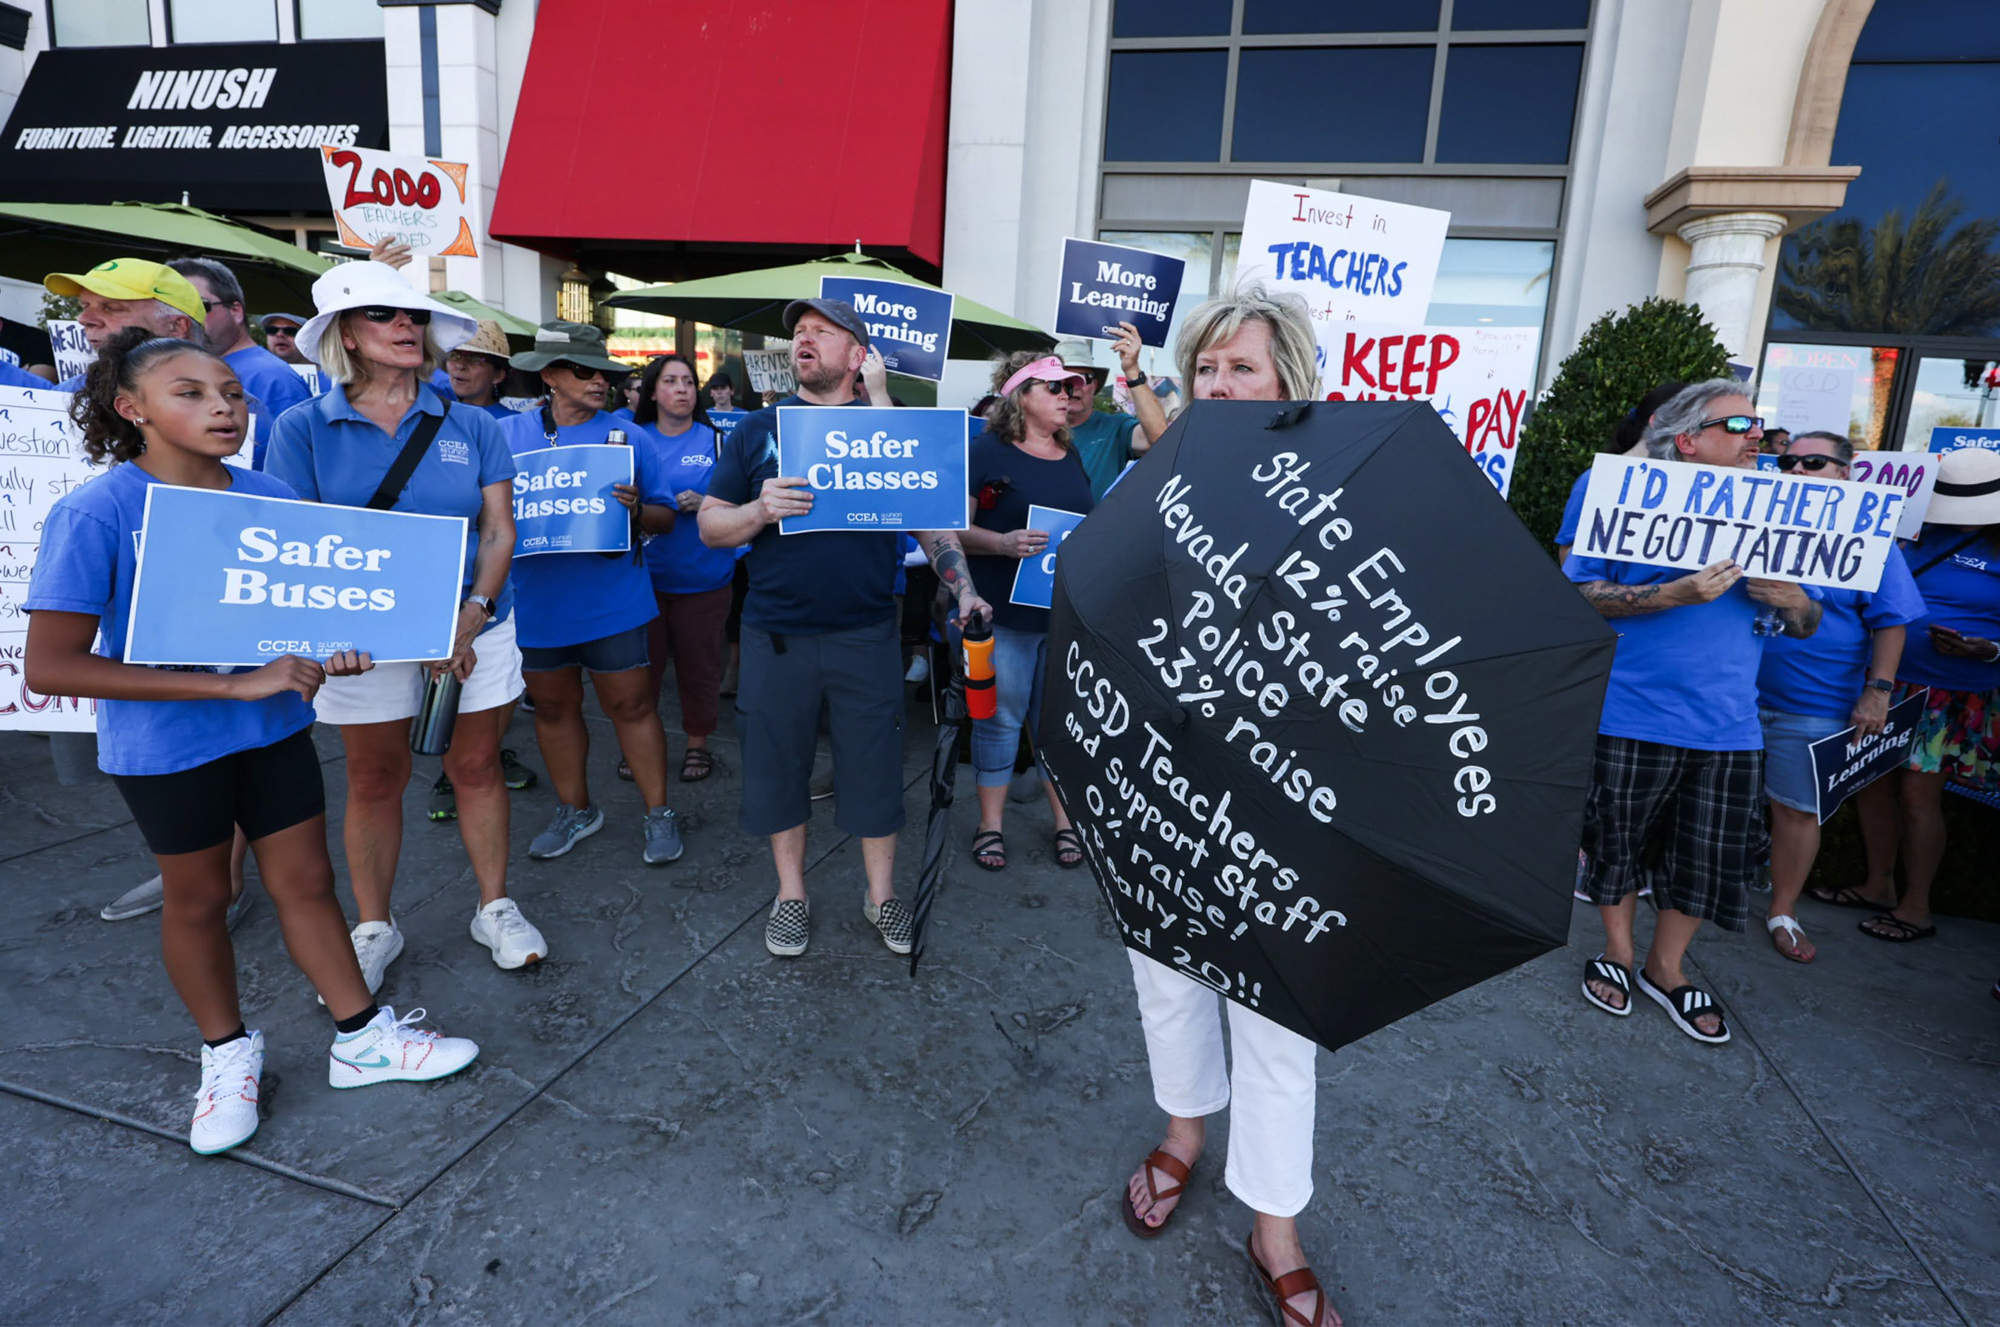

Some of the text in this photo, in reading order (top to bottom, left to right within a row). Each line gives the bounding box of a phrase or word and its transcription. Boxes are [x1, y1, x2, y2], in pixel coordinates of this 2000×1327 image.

[127, 68, 277, 110] NINUSH
[218, 124, 360, 149] ACCESSORIES
[331, 150, 441, 210] 2000
[356, 206, 438, 228] TEACHERS
[1292, 193, 1388, 235] Invest in
[1096, 260, 1157, 291] More
[1268, 241, 1408, 298] TEACHERS
[853, 293, 918, 321] More
[1070, 282, 1170, 322] Learning
[1346, 309, 1356, 321] in
[66, 324, 93, 356] JUS
[864, 321, 939, 353] arning
[1341, 332, 1460, 396] KEEP
[1464, 387, 1527, 455] PAY
[438, 440, 469, 451] CCEA
[681, 454, 713, 465] CCEA
[825, 429, 920, 459] Safer
[1953, 435, 2000, 448] Safer
[513, 466, 588, 495] Safer
[807, 463, 939, 491] Classes
[1854, 460, 1926, 498] 2000
[512, 497, 606, 521] lasses
[846, 512, 879, 522] CCEA
[1617, 462, 1903, 539] I'D RATHER BE
[237, 527, 392, 572] Safer
[523, 537, 549, 548] CCEA
[219, 568, 396, 612] Buses
[1155, 473, 1368, 733] Nevada State
[257, 640, 312, 653] CCEA
[1181, 590, 1290, 718] Police
[1251, 451, 1353, 551] State
[1347, 546, 1497, 818] Employees
[1275, 550, 1417, 728] 12% raise
[1137, 617, 1337, 824] 23% raise
[1828, 727, 1913, 793] Learning
[1845, 721, 1895, 762] Moe
[1066, 640, 1130, 737] CCSD
[1139, 721, 1300, 891] Teachers
[1065, 711, 1101, 758] and
[1213, 864, 1347, 944] Staff
[1085, 784, 1123, 839] 0%
